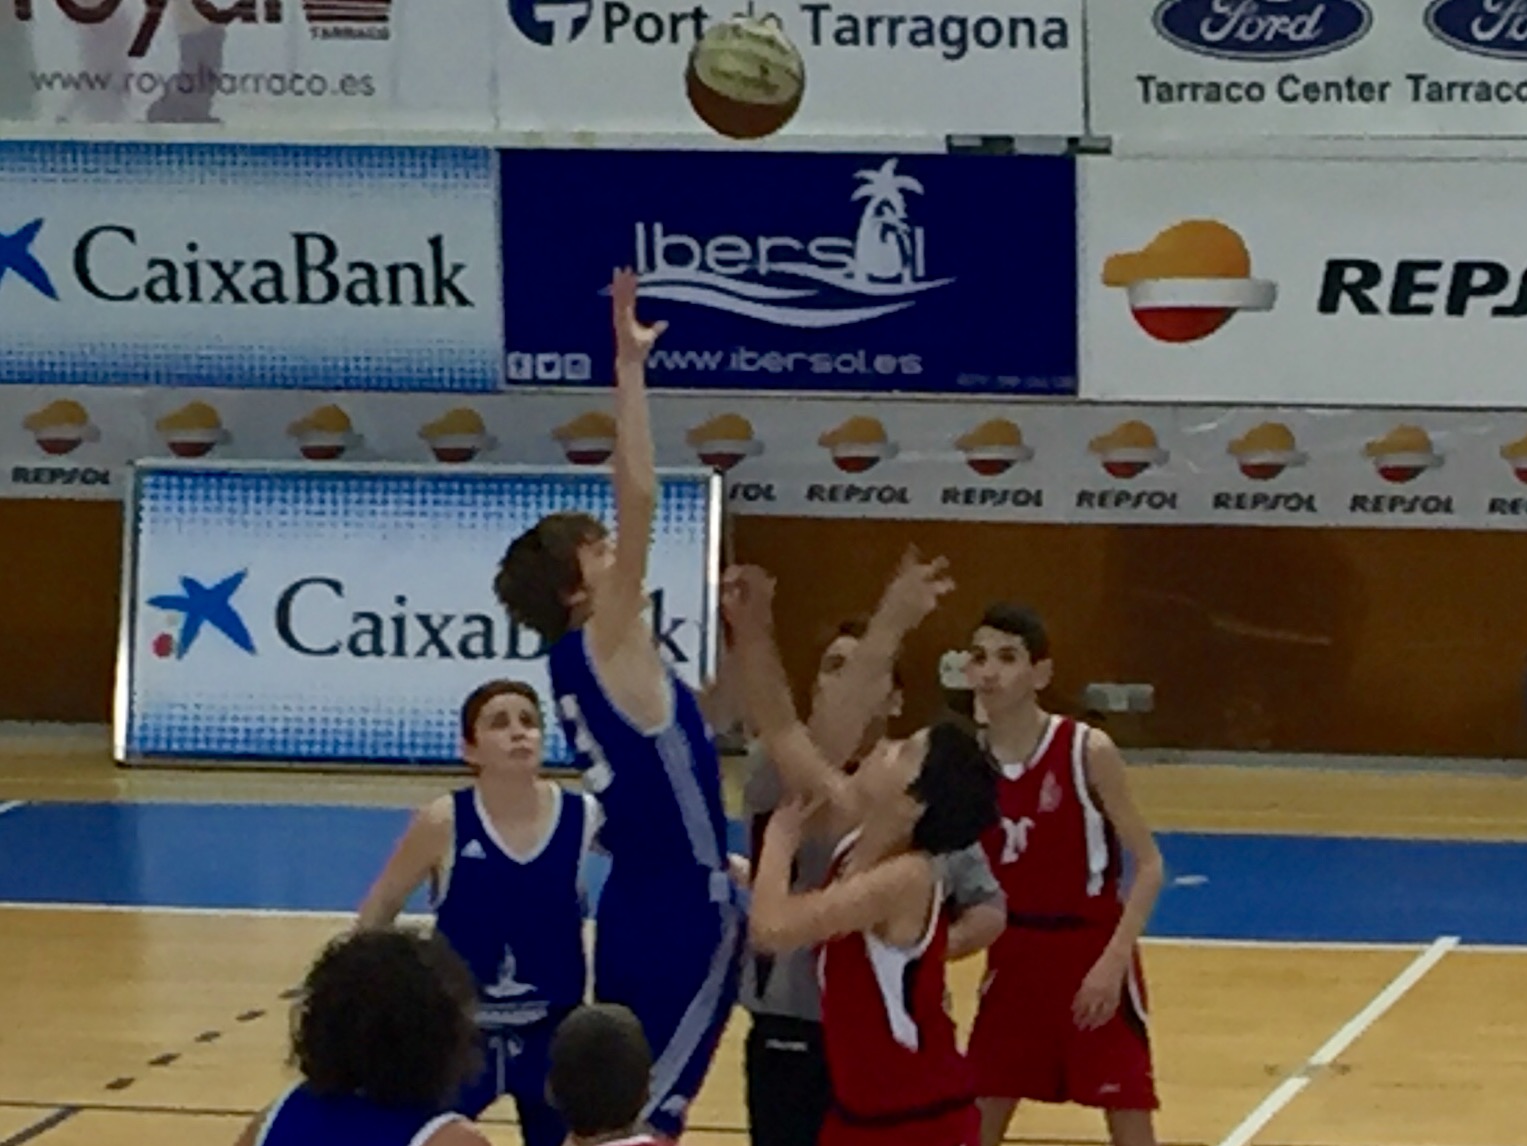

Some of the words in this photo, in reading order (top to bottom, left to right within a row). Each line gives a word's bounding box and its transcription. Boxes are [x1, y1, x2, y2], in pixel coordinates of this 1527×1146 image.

[604, 2, 710, 45] Port
[801, 3, 1068, 61] Tarragona
[1200, 0, 1322, 42] Ford
[1136, 74, 1265, 104] Tarraco
[1277, 73, 1391, 104] Center
[73, 224, 475, 308] CaixaBank
[9, 465, 112, 487] REPSOL
[806, 484, 910, 505] REPSOL
[941, 487, 1043, 508] REPSOL
[1075, 489, 1179, 510] REPSOL
[1213, 492, 1318, 513] REPSOL
[1349, 494, 1454, 515] REPSOL
[275, 576, 691, 663] Caixak
